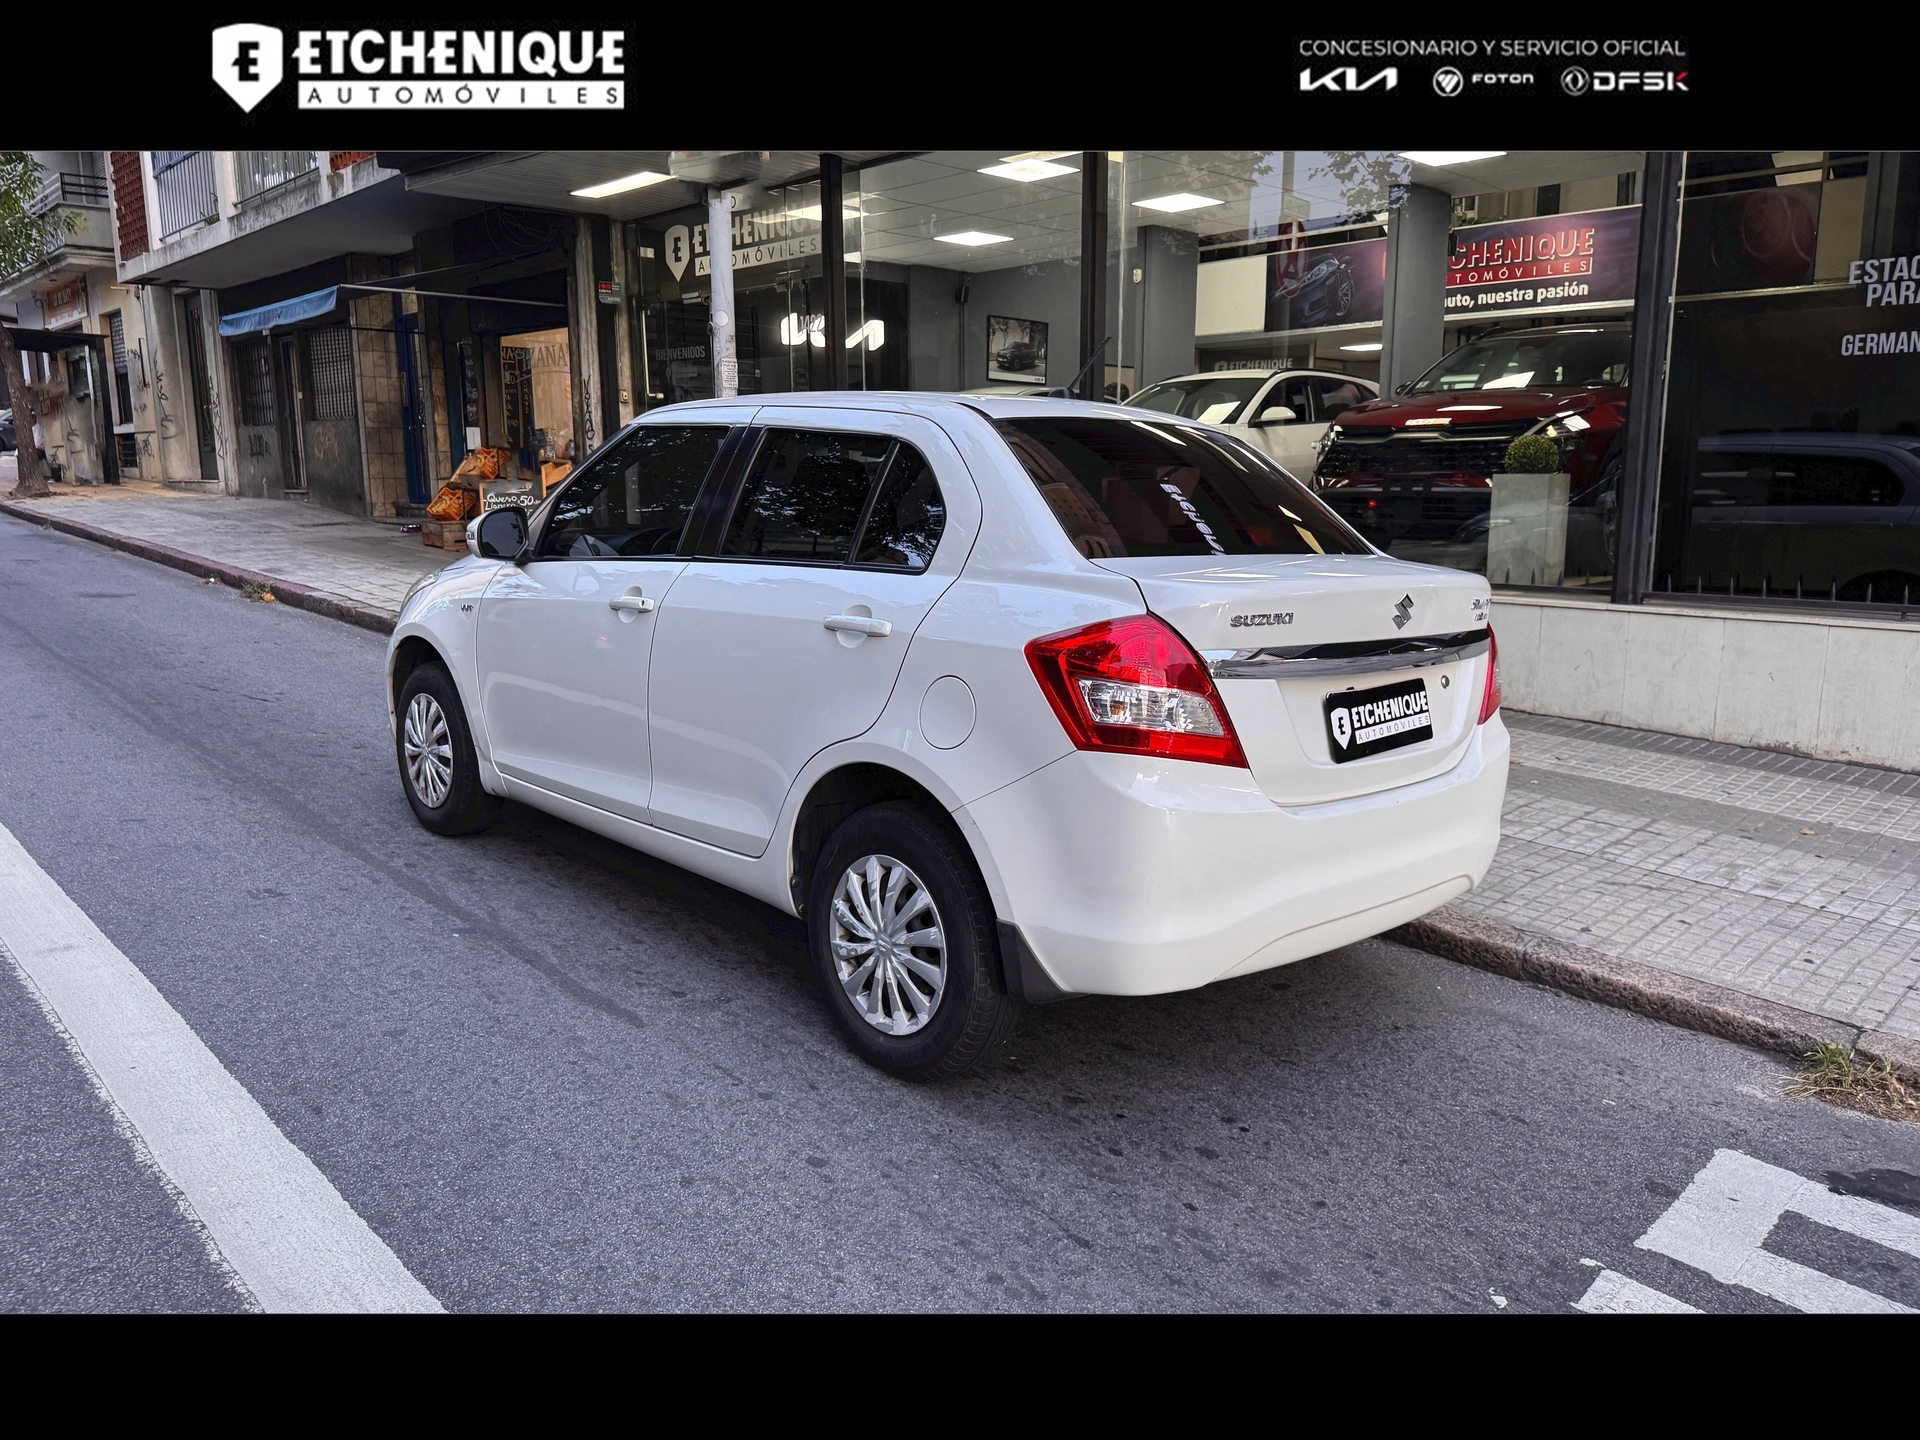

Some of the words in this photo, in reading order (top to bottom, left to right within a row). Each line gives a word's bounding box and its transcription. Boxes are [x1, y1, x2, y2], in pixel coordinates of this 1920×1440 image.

[698, 238, 817, 272] AOMÓVILES
[1449, 227, 1595, 269] CHENIQUE
[1447, 262, 1588, 286] TOMÓVILES
[1445, 294, 1475, 308] uto,
[1477, 287, 1534, 305] nuestra
[1537, 281, 1589, 303] pasión
[656, 345, 706, 361] BIENVENIDOS
[1229, 358, 1294, 371] ETCHENIQUE
[1230, 612, 1294, 628] SUZUKI
[1351, 690, 1429, 728] ETCHENIQUE
[1358, 715, 1430, 741] AUTOMÓVILES
